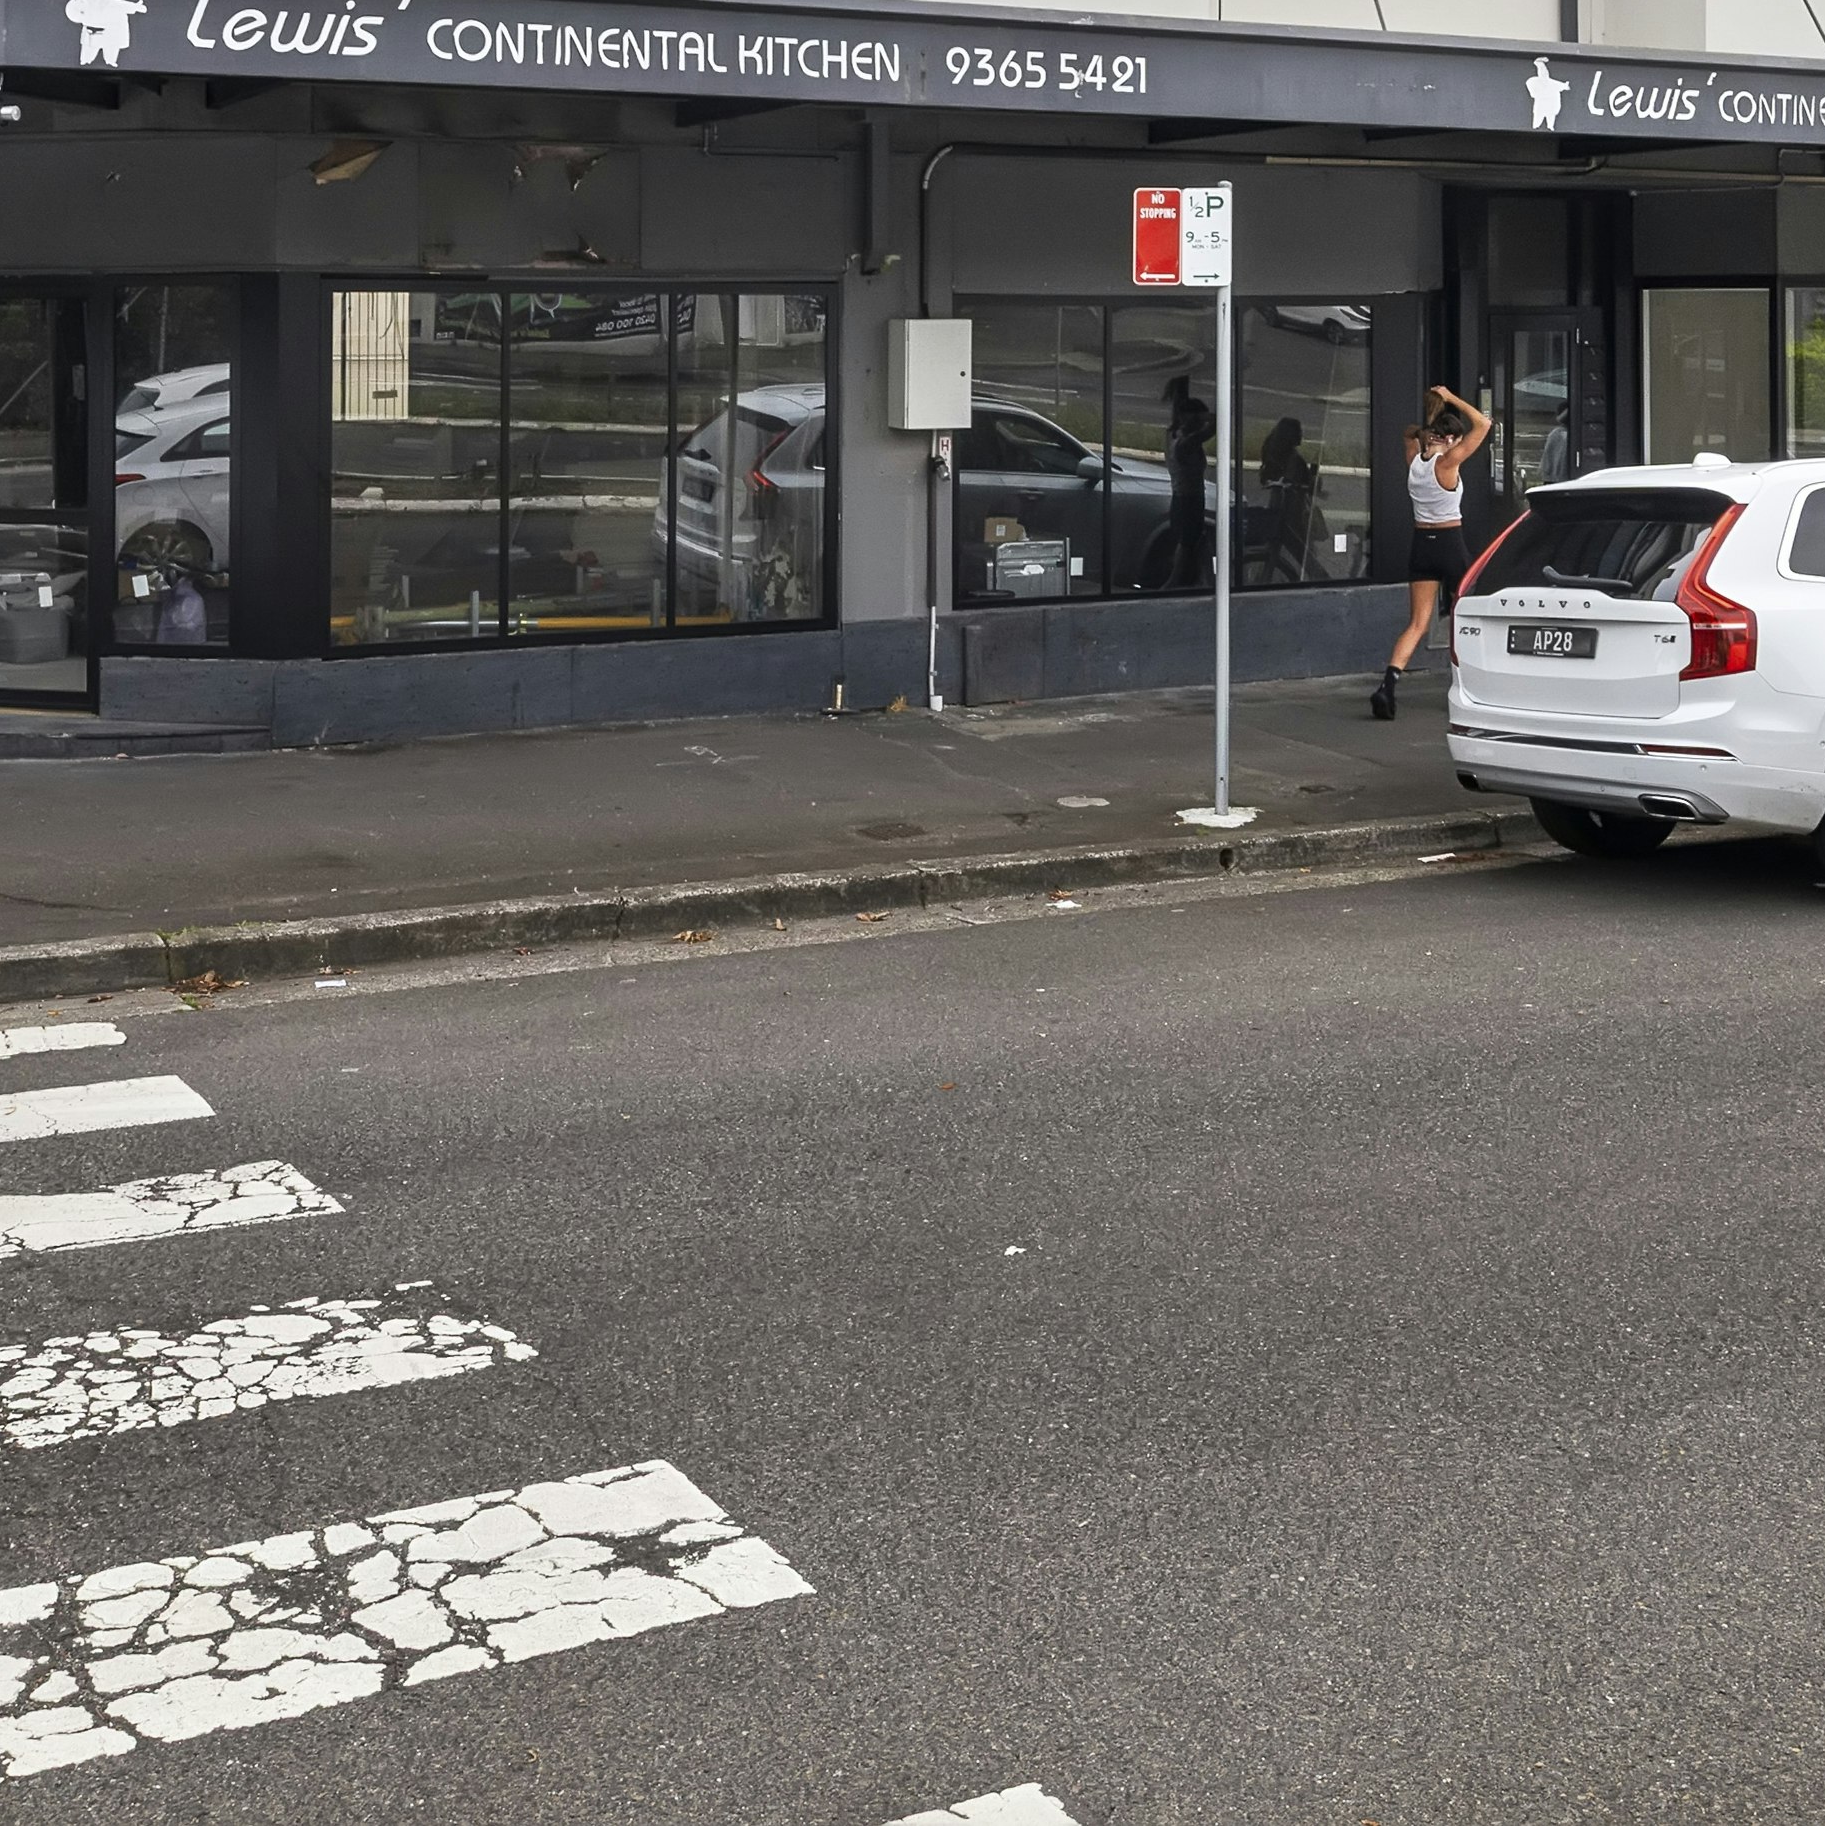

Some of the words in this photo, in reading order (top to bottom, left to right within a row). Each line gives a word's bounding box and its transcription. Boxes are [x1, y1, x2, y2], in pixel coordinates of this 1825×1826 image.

[425, 17, 728, 75] CONTINENTAL
[738, 33, 902, 84] KITCHEN
[945, 48, 1048, 91] 9365
[1059, 53, 1148, 97] 5421
[1151, 193, 1166, 205] NO
[1140, 207, 1176, 219] STOPPING
[1500, 598, 1591, 609] VOLVO
[1533, 630, 1574, 652] AP28
